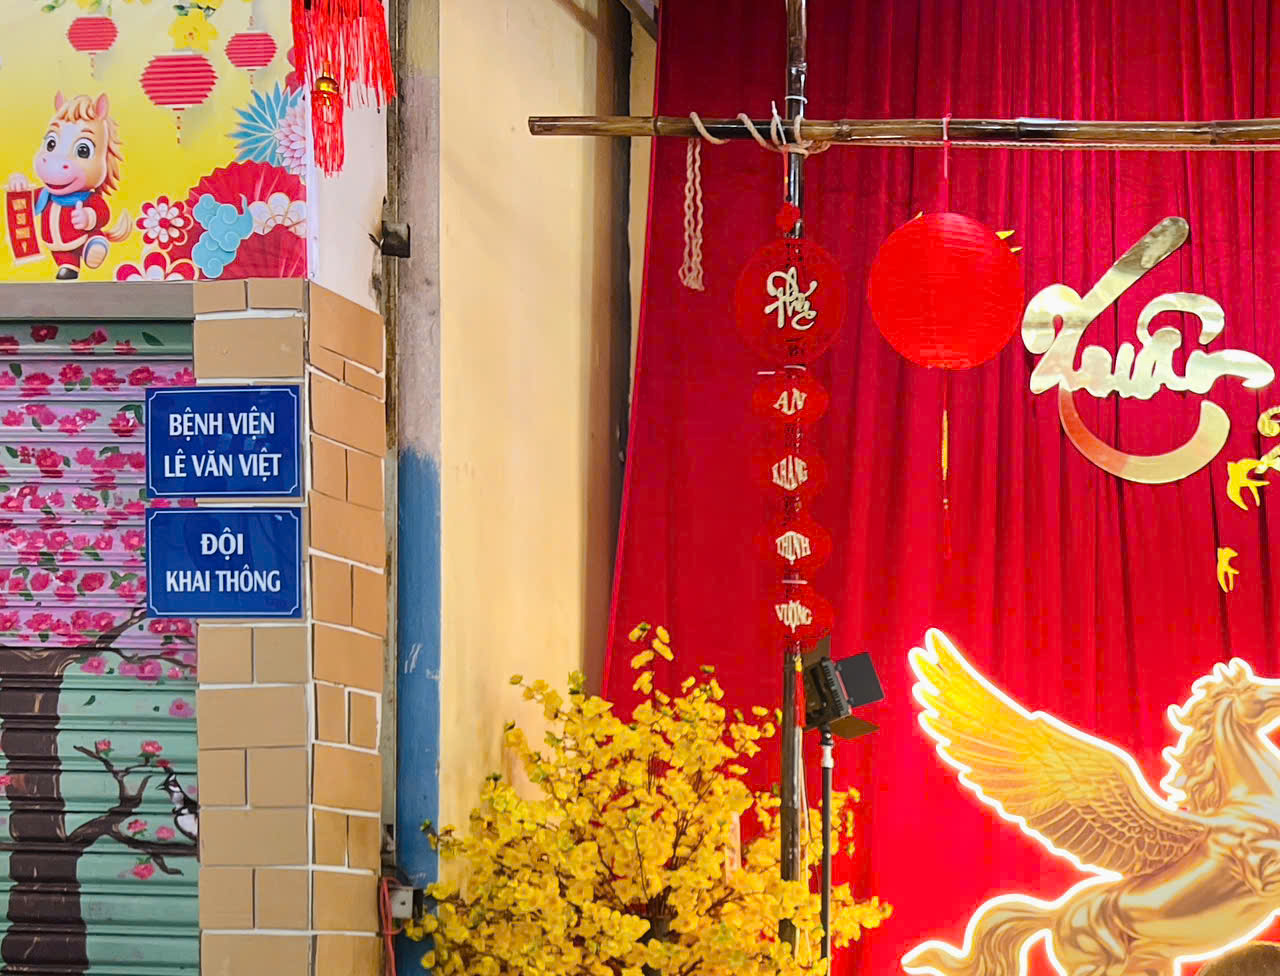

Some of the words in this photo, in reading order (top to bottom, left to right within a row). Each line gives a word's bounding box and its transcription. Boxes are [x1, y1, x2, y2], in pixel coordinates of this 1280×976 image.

[773, 388, 807, 415] AN
[168, 406, 223, 441] BỆNH
[228, 405, 275, 441] VIỆN
[164, 448, 187, 477] LÊ
[191, 449, 233, 477] VĂN
[238, 447, 282, 482] VIỆT
[772, 454, 808, 491] KHANG
[200, 526, 244, 561] ĐỘI
[775, 530, 811, 565] THỊNH
[166, 569, 211, 593] KHAI
[215, 564, 281, 593] THÔNG
[774, 600, 813, 634] VƯỢNG
